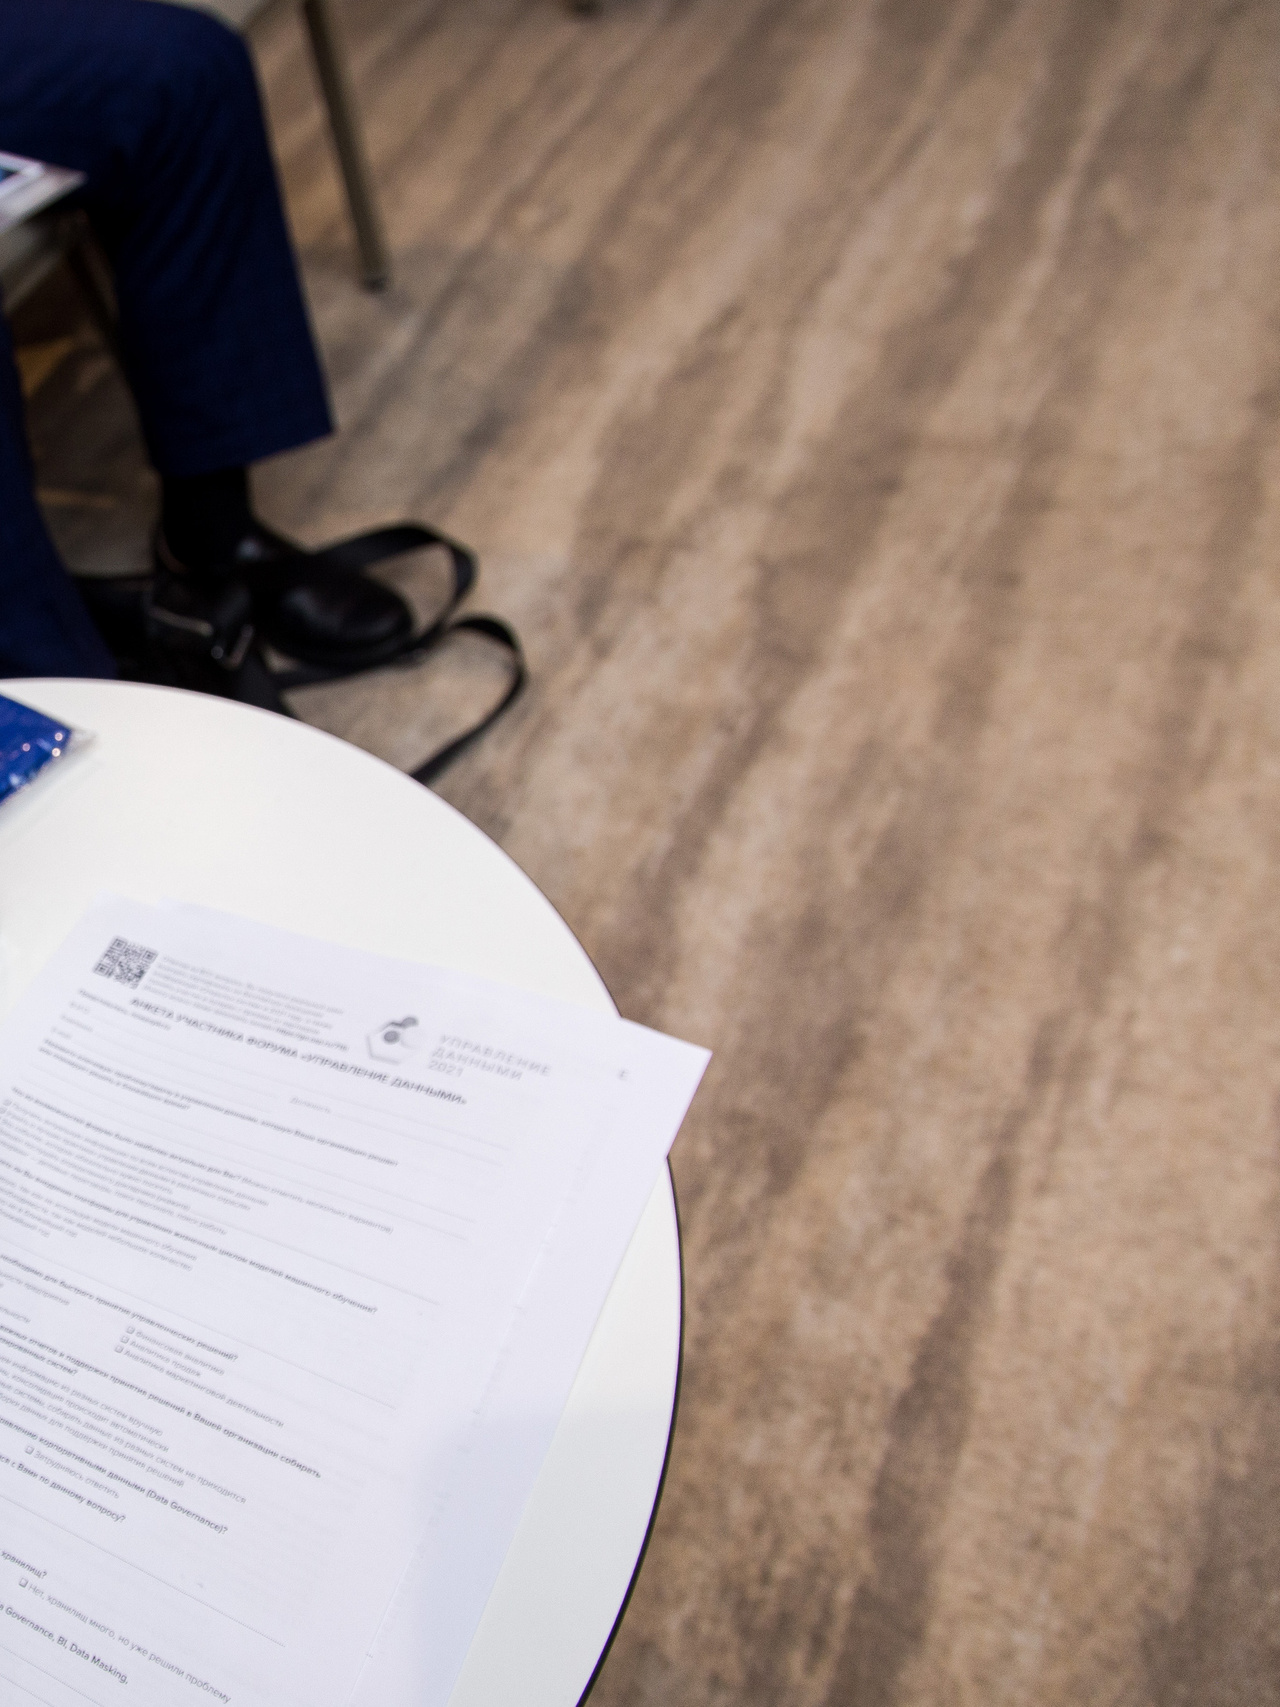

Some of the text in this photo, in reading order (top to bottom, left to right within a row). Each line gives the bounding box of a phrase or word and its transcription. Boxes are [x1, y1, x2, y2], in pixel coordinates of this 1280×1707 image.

[130, 998, 174, 1019] АНКЕТА
[175, 1013, 244, 1042] УЧАСТНИКА
[246, 1036, 298, 1057] ФОРУМА
[300, 1053, 389, 1083] «УПРАВЛЕНИЕ
[389, 1077, 467, 1105] ДАННЫМИ»
[426, 1059, 464, 1078] 2021
[430, 1046, 523, 1081] ДАННЫМИ
[439, 1033, 551, 1077] УПРАВЛЕНИЕ
[38, 1436, 107, 1474] корпоративными
[106, 1470, 146, 1494] данными
[145, 1488, 169, 1506] (Data
[169, 1500, 229, 1534] Governance)?
[0, 1550, 48, 1579] хранилищ?
[4, 1605, 55, 1642] Governance,
[56, 1634, 68, 1649] BI,
[68, 1642, 90, 1661] Data
[90, 1654, 128, 1685] Masking,
[46, 1594, 89, 1624] хранилищ
[88, 1618, 115, 1638] много,
[117, 1634, 130, 1646] но
[129, 1642, 149, 1657] уже
[147, 1652, 185, 1677] решили
[184, 1672, 232, 1705] проблему
